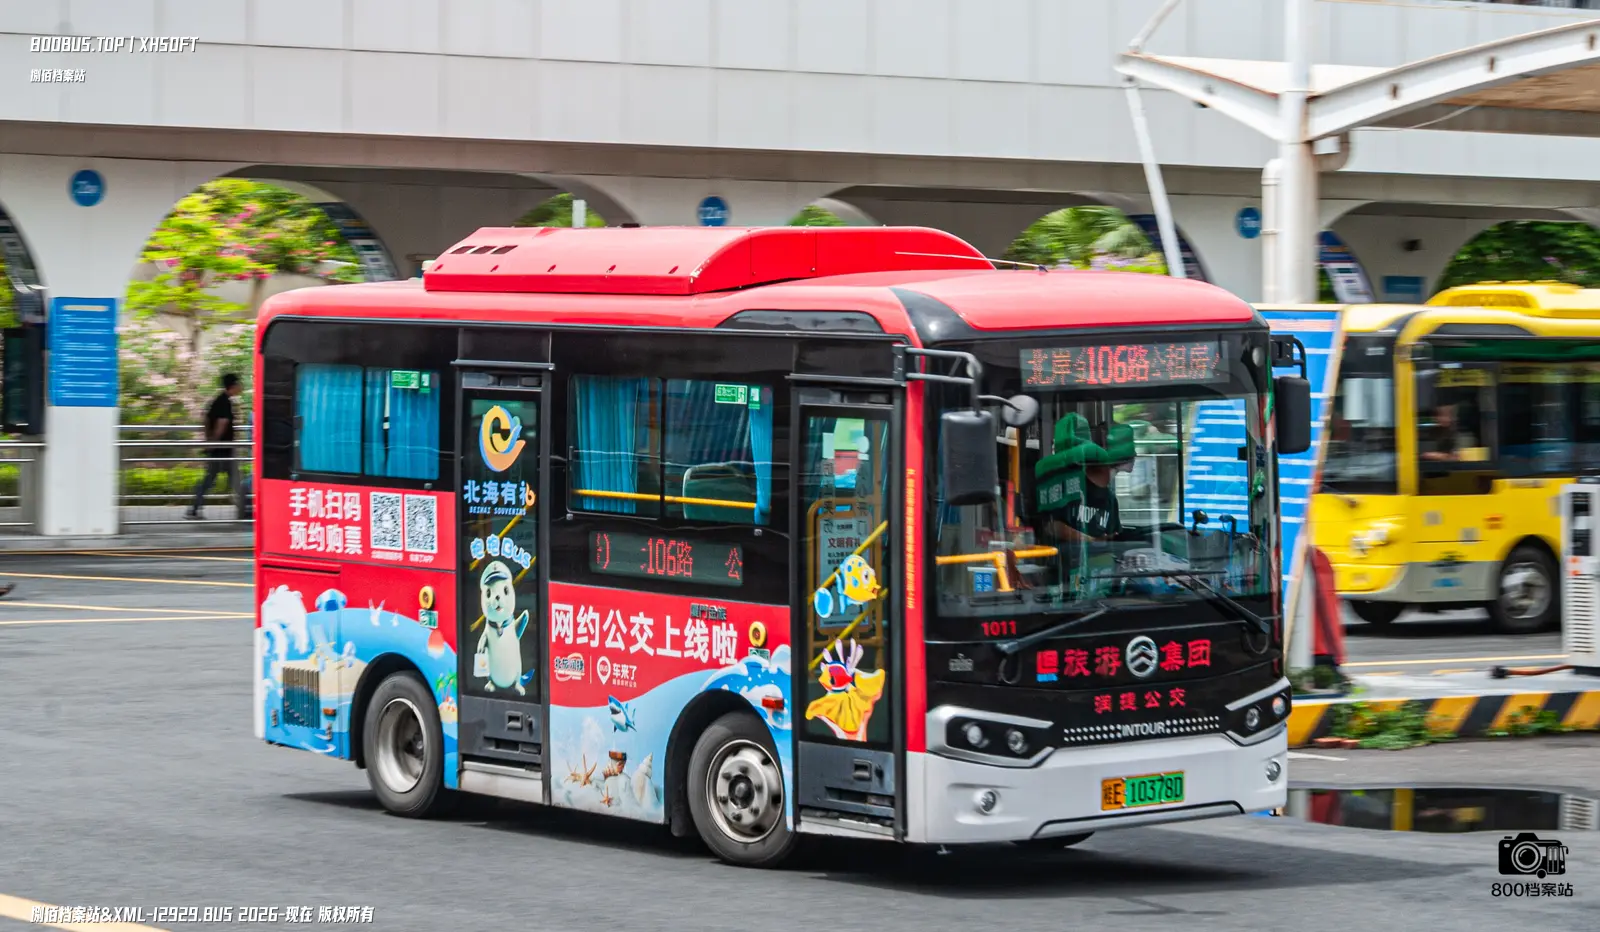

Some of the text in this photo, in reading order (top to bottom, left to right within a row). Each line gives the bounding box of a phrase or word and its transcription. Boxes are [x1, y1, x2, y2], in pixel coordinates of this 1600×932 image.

[289, 488, 361, 521] 手机扫码
[463, 480, 536, 506] 北海有礼
[469, 506, 527, 516] BEIHAI SOUVENIRS
[289, 521, 363, 555] 预约购票
[551, 603, 738, 665] 网约公交上线啦
[981, 621, 1017, 636] 1011
[1064, 639, 1212, 677] 旅游 集团
[613, 663, 637, 680] 车来了
[1122, 721, 1165, 736] INTOUR
